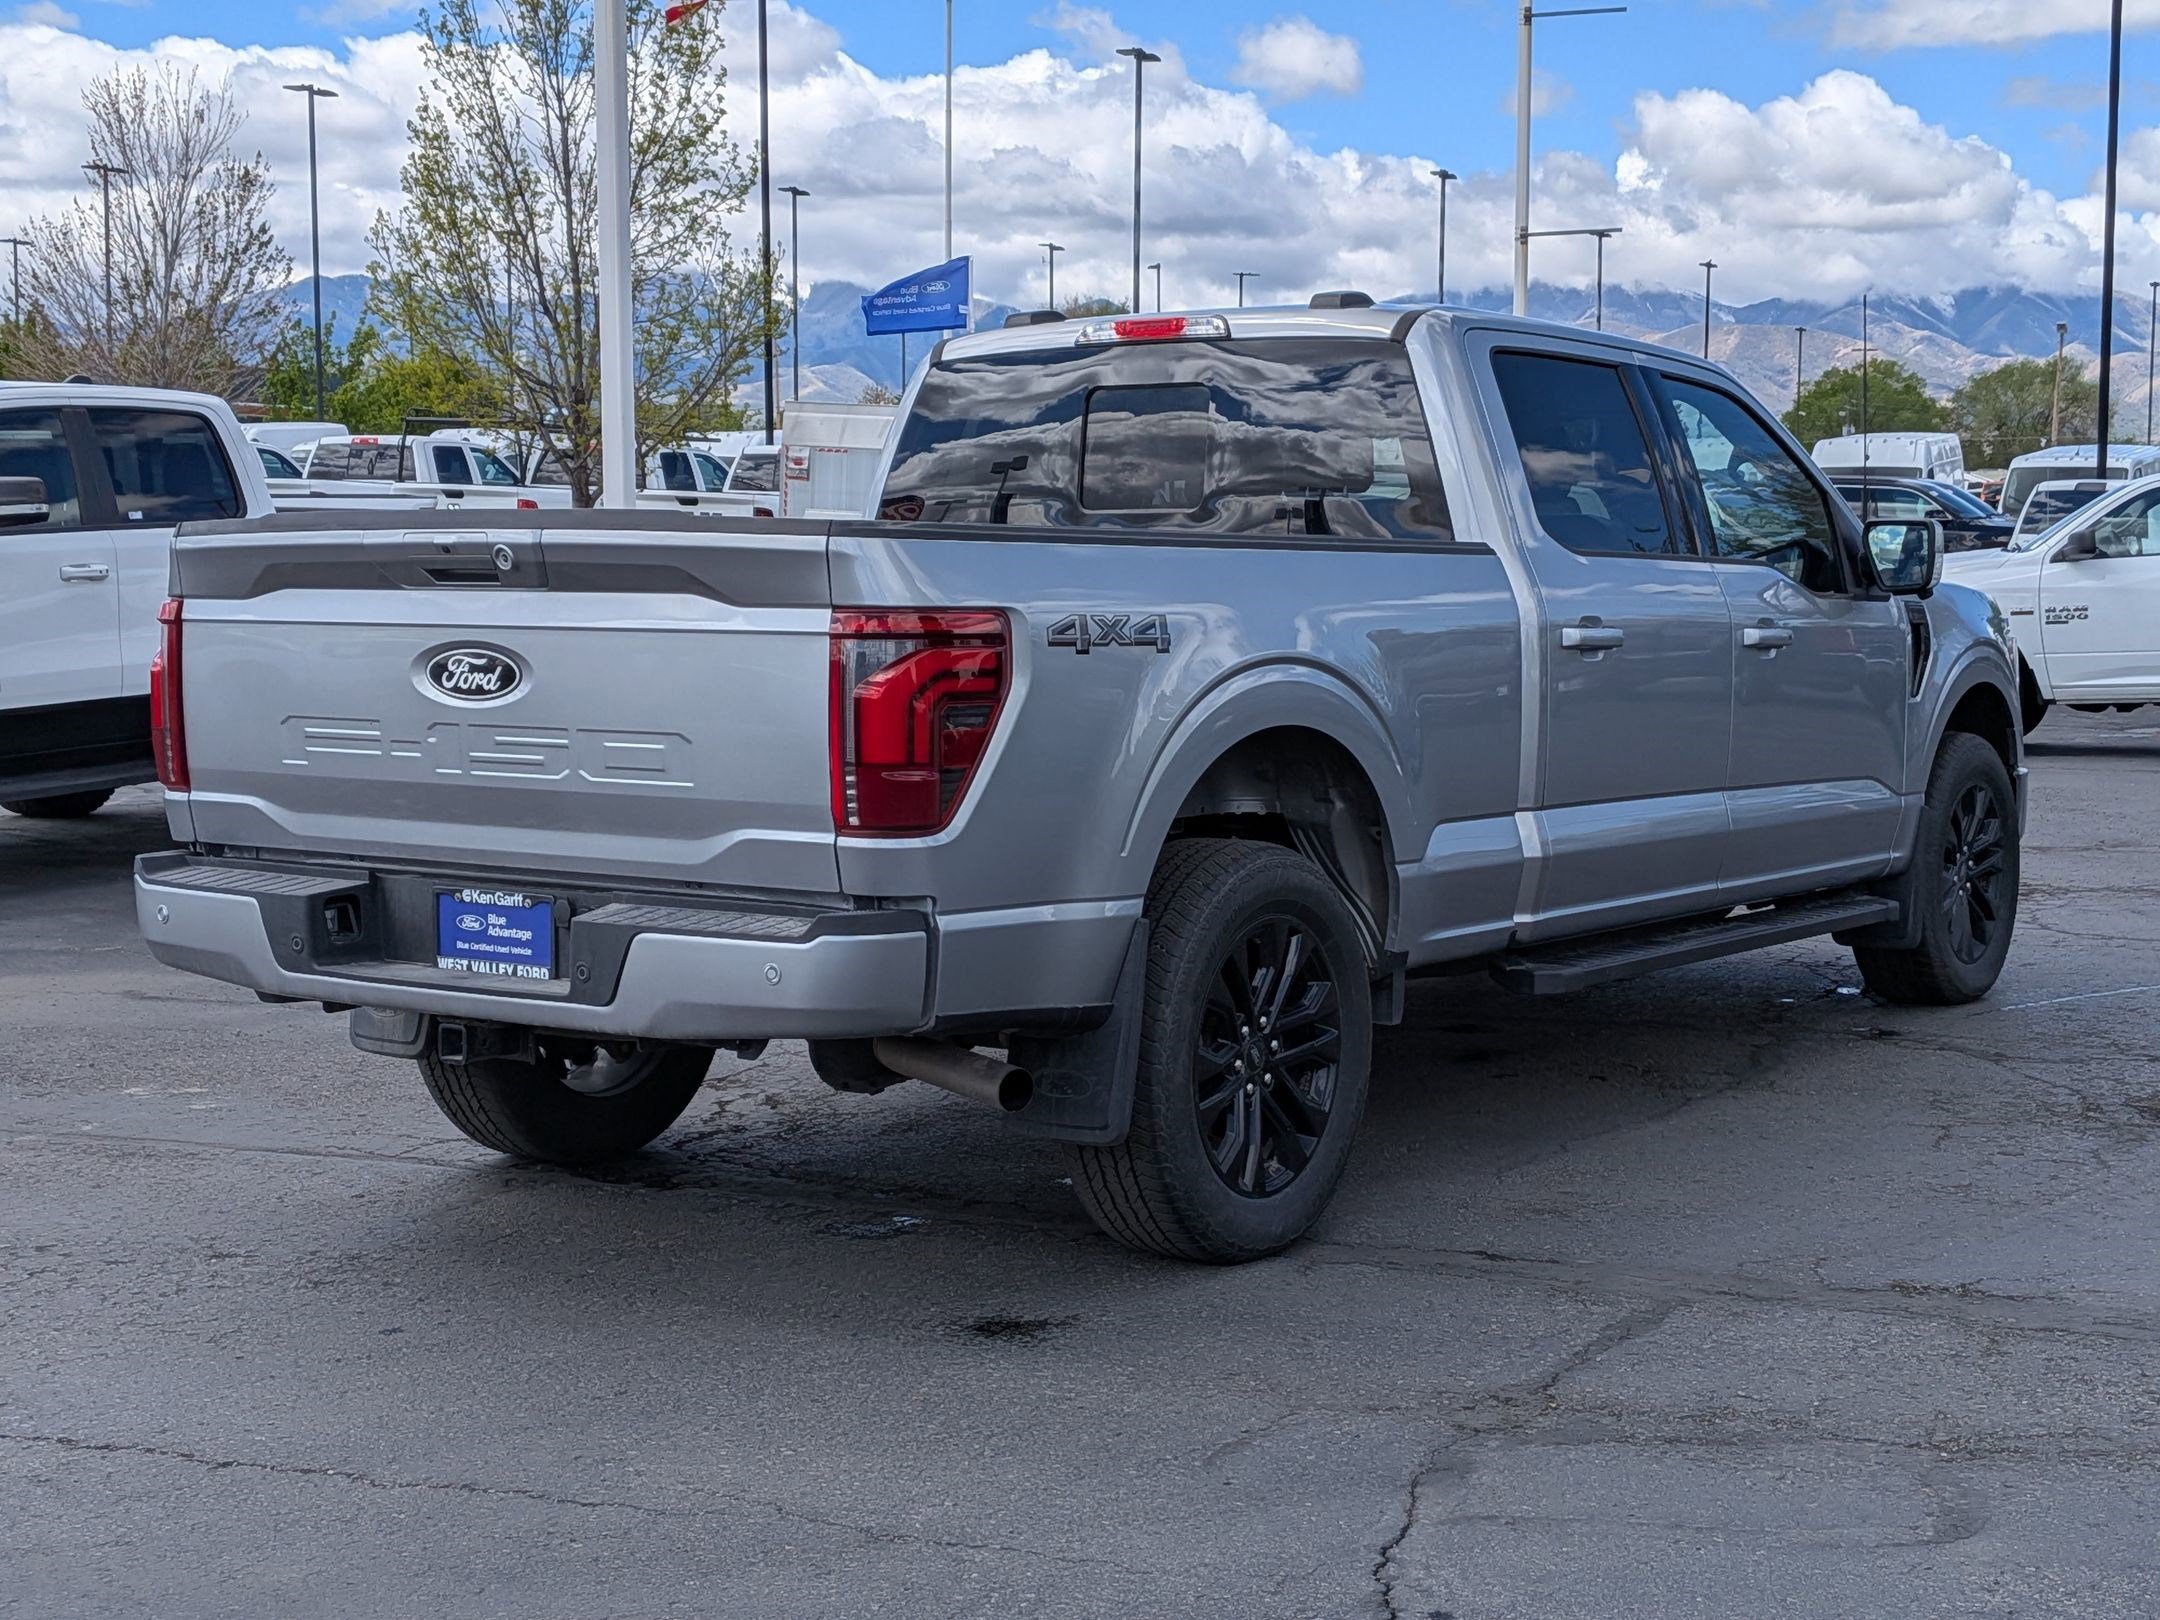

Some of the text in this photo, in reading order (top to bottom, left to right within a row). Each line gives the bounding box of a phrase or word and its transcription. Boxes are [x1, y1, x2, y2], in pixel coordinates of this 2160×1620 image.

[441, 655, 502, 691] Ford
[280, 715, 694, 787] F-150
[462, 916, 480, 928] Ford
[487, 913, 507, 926] Blue
[487, 926, 532, 941] Advantage
[456, 940, 532, 956] Blue Certified Used Vehicle
[437, 957, 549, 980] WEST VALLEY FORD
